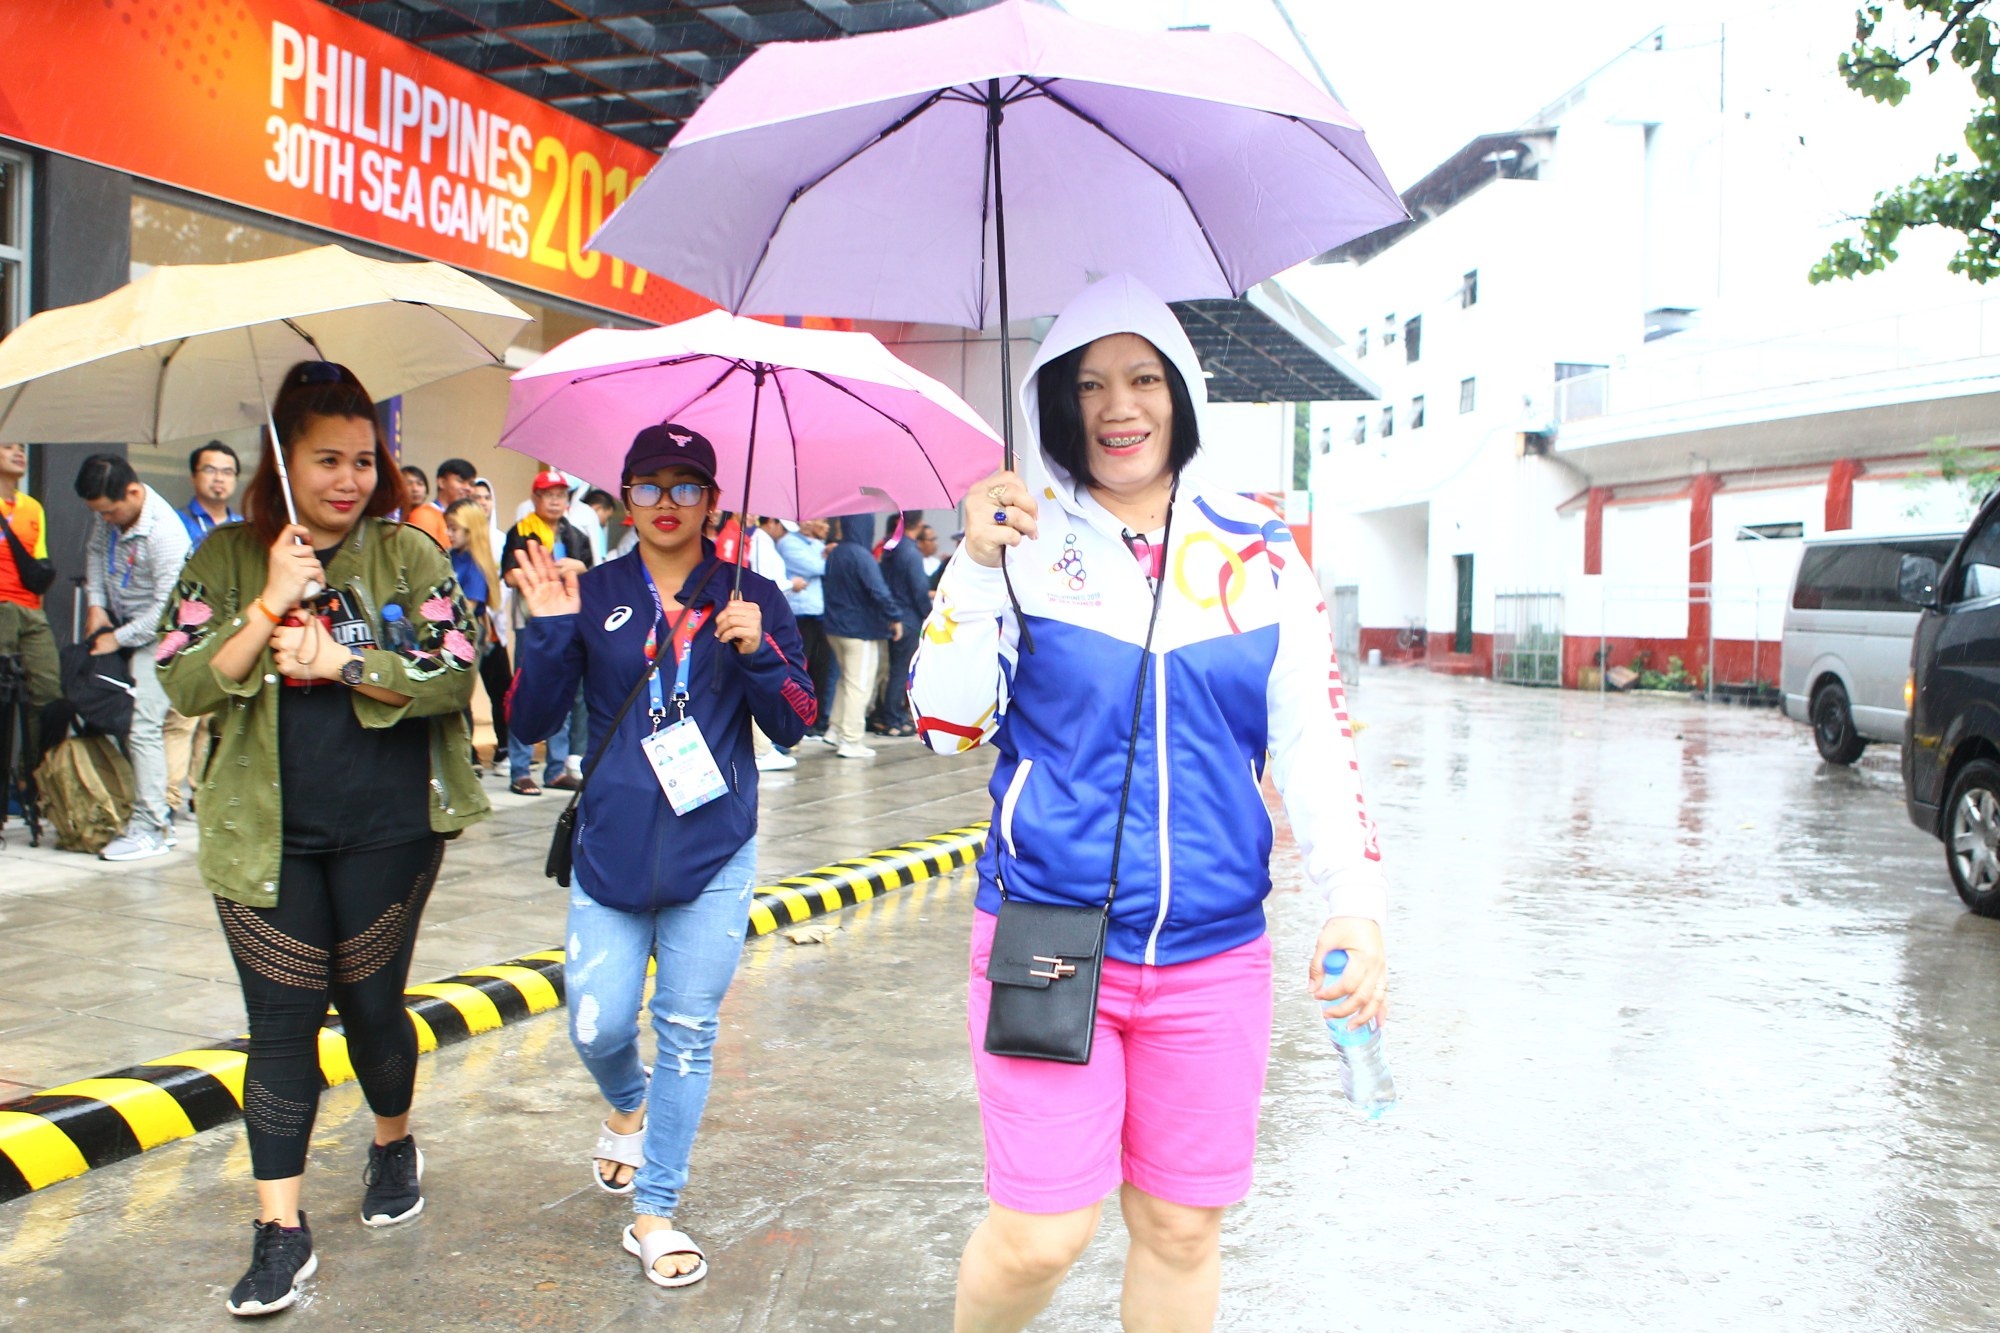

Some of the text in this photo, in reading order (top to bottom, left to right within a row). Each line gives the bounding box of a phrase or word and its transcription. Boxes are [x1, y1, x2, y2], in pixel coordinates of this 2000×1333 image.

[264, 114, 530, 259] 30TH SEA GAMES
[270, 19, 533, 199] PHILIPPINES
